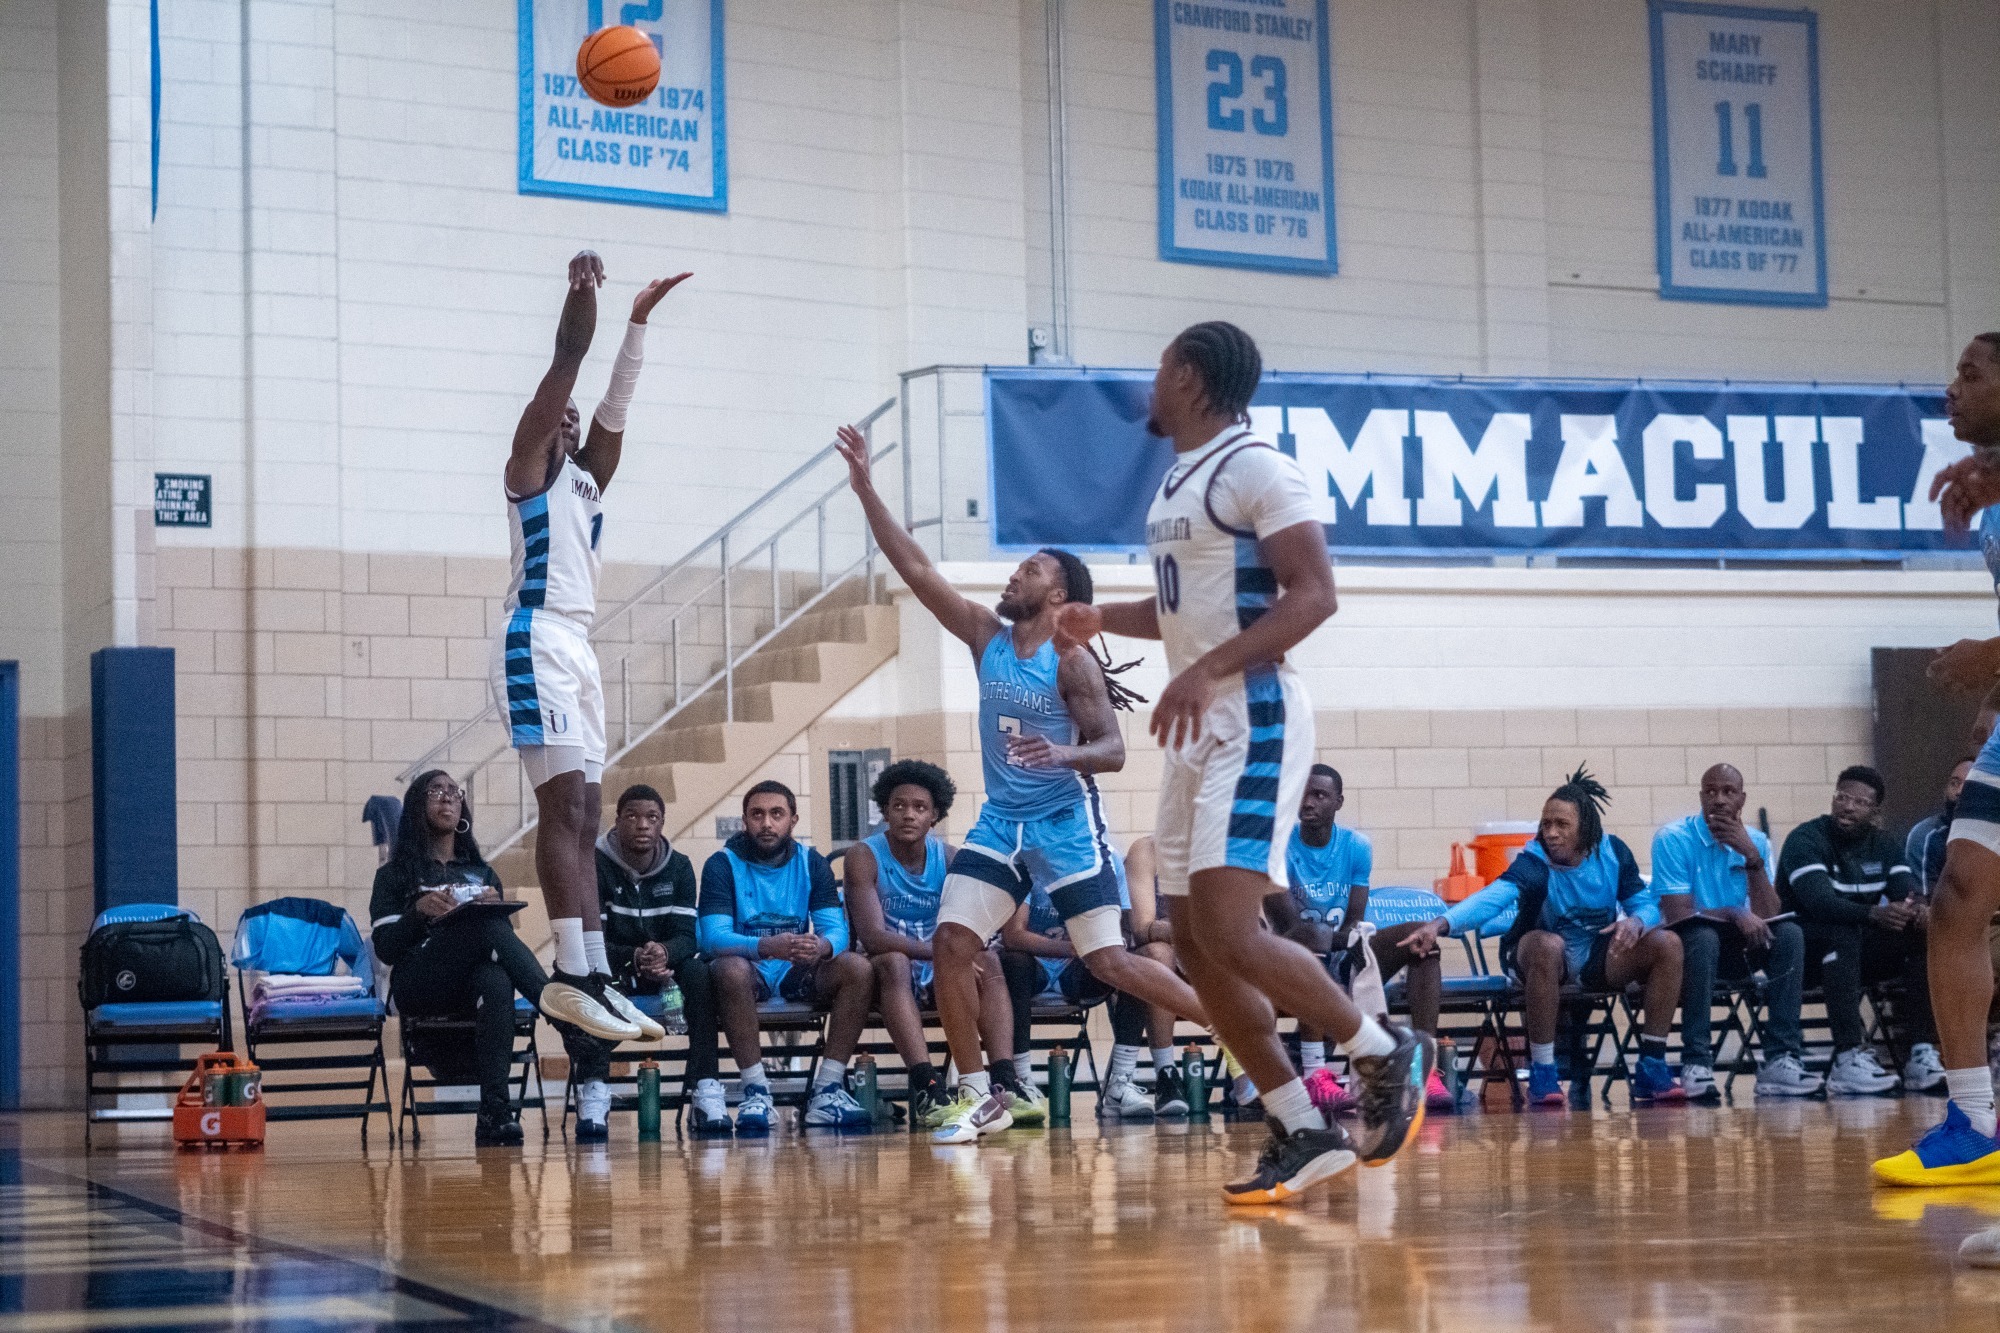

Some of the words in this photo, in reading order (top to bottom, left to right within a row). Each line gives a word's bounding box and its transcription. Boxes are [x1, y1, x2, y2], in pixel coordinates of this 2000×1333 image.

[1173, 2, 1251, 33] CRAWFORD
[1255, 13, 1312, 41] STANLEY
[1708, 31, 1762, 56] MARY
[1696, 60, 1778, 85] SCHARFF
[659, 87, 704, 112] 1974
[1206, 50, 1288, 137] 23
[548, 105, 698, 142] ALL-AMERICAN
[1714, 100, 1768, 179] 11
[557, 137, 621, 165] CLASS
[628, 145, 653, 167] OF
[660, 148, 690, 172] '74
[1206, 153, 1247, 177] 1975
[1254, 158, 1295, 182] 1976
[1180, 177, 1224, 203] KODAK
[1227, 186, 1320, 212] ALL-AMERICAN
[1695, 197, 1732, 218] 1977
[1194, 208, 1249, 233] CLASS
[1255, 214, 1275, 235] OF
[1682, 221, 1804, 247] ALL-AMERICAN
[1689, 249, 1741, 271] CLASS
[1747, 252, 1768, 272] OF
[164, 479, 204, 491] SMOKING
[187, 490, 199, 501] OR
[159, 511, 178, 522] THIS
[184, 511, 207, 523] AREA
[1154, 553, 1181, 615] 10
[1013, 685, 1053, 715] DAME
[854, 1070, 866, 1087] G
[1187, 1061, 1202, 1077] G
[200, 1111, 221, 1136] G
